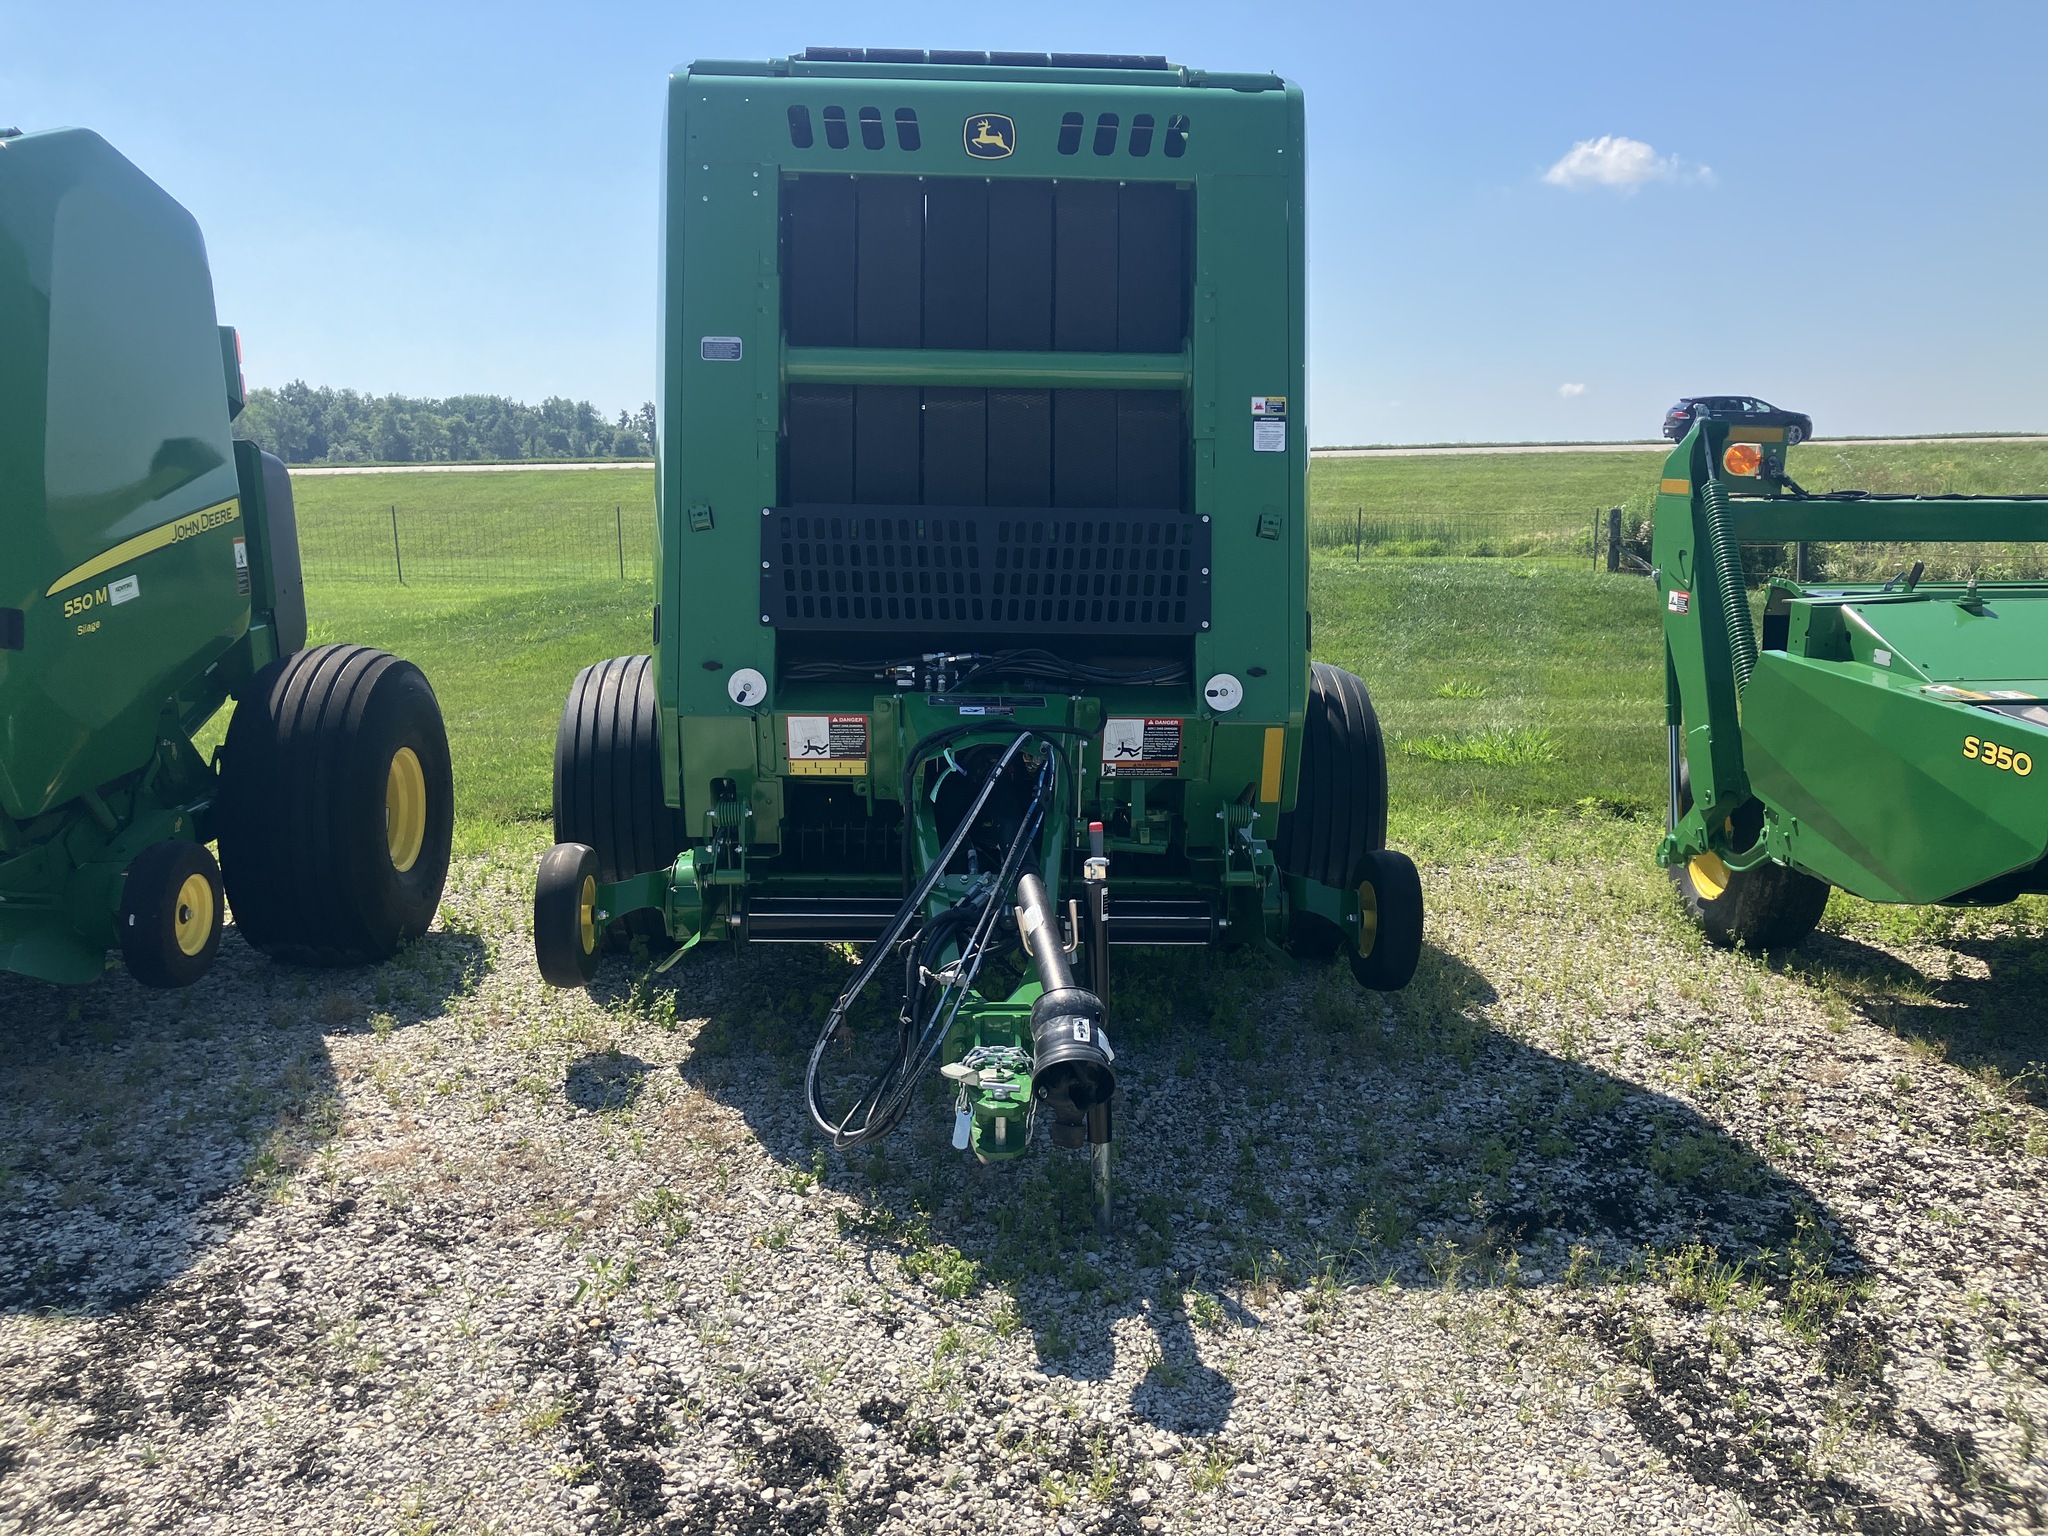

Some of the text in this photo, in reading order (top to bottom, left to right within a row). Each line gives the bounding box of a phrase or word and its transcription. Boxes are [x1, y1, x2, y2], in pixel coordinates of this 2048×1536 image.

[171, 507, 233, 543] JOHN DEERE
[63, 586, 108, 618] 550 M
[77, 620, 101, 636] Silage
